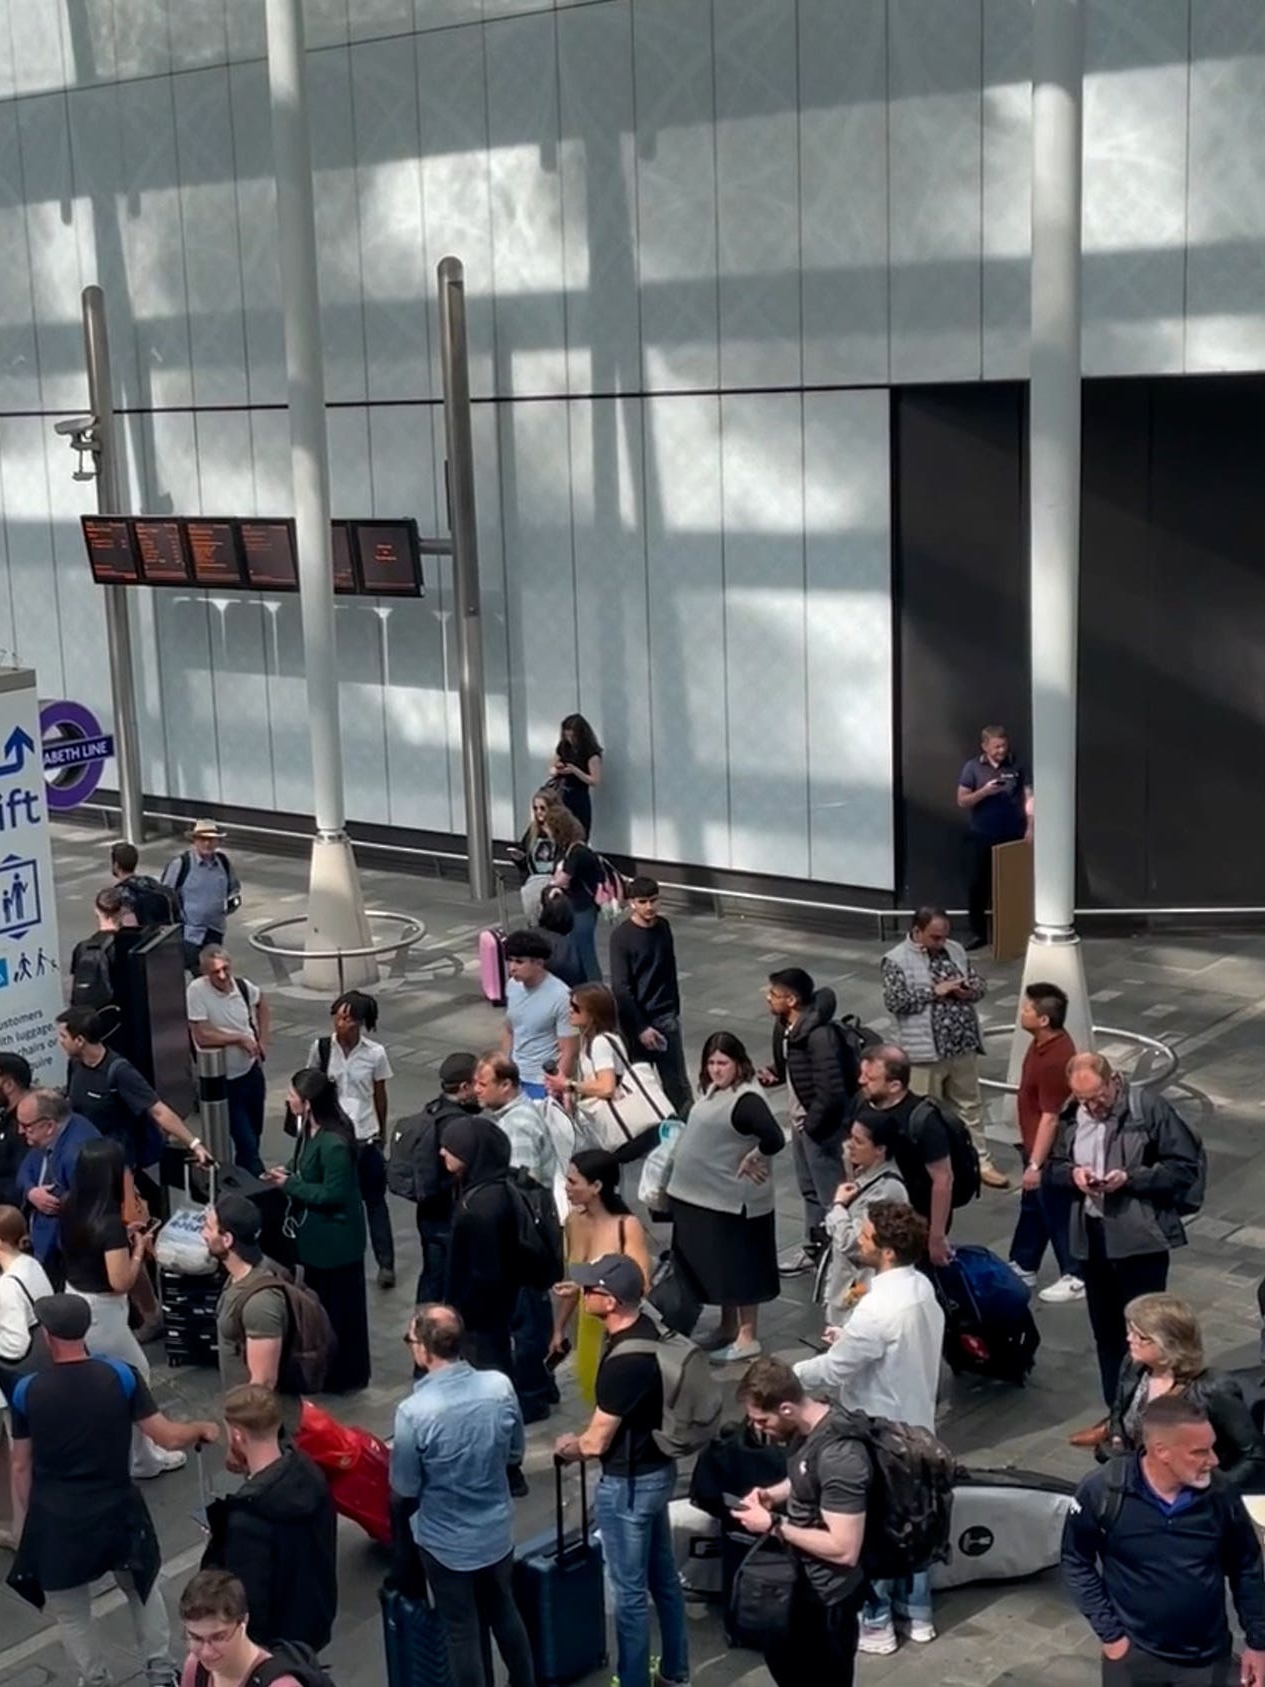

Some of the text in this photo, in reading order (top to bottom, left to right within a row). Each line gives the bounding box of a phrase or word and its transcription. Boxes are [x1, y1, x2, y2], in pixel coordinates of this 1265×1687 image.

[43, 741, 108, 764] ABETH LINE
[17, 1042, 45, 1057] chairs
[30, 1056, 53, 1073] quire
